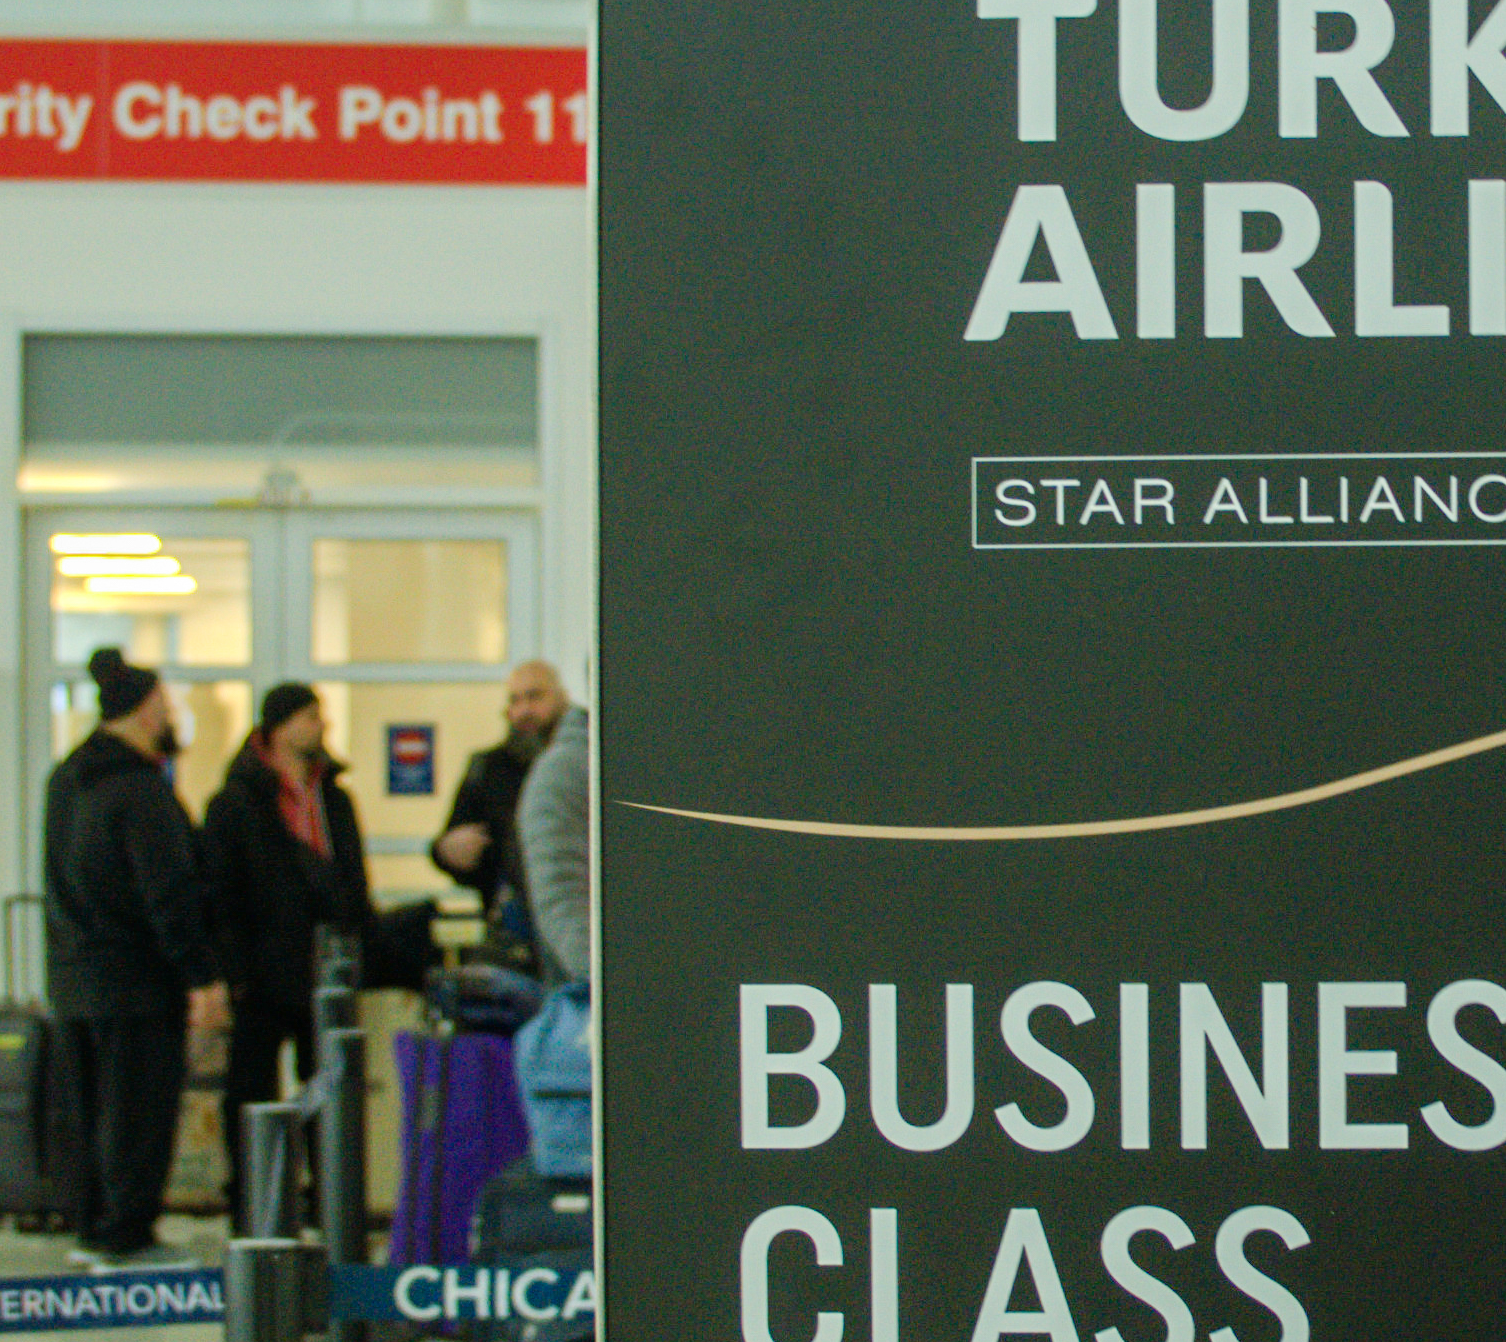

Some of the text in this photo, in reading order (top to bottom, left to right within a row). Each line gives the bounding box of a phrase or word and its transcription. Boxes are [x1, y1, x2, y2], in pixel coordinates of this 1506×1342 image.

[112, 82, 319, 141] Check
[338, 87, 504, 143] Point
[994, 475, 1176, 527] STAR
